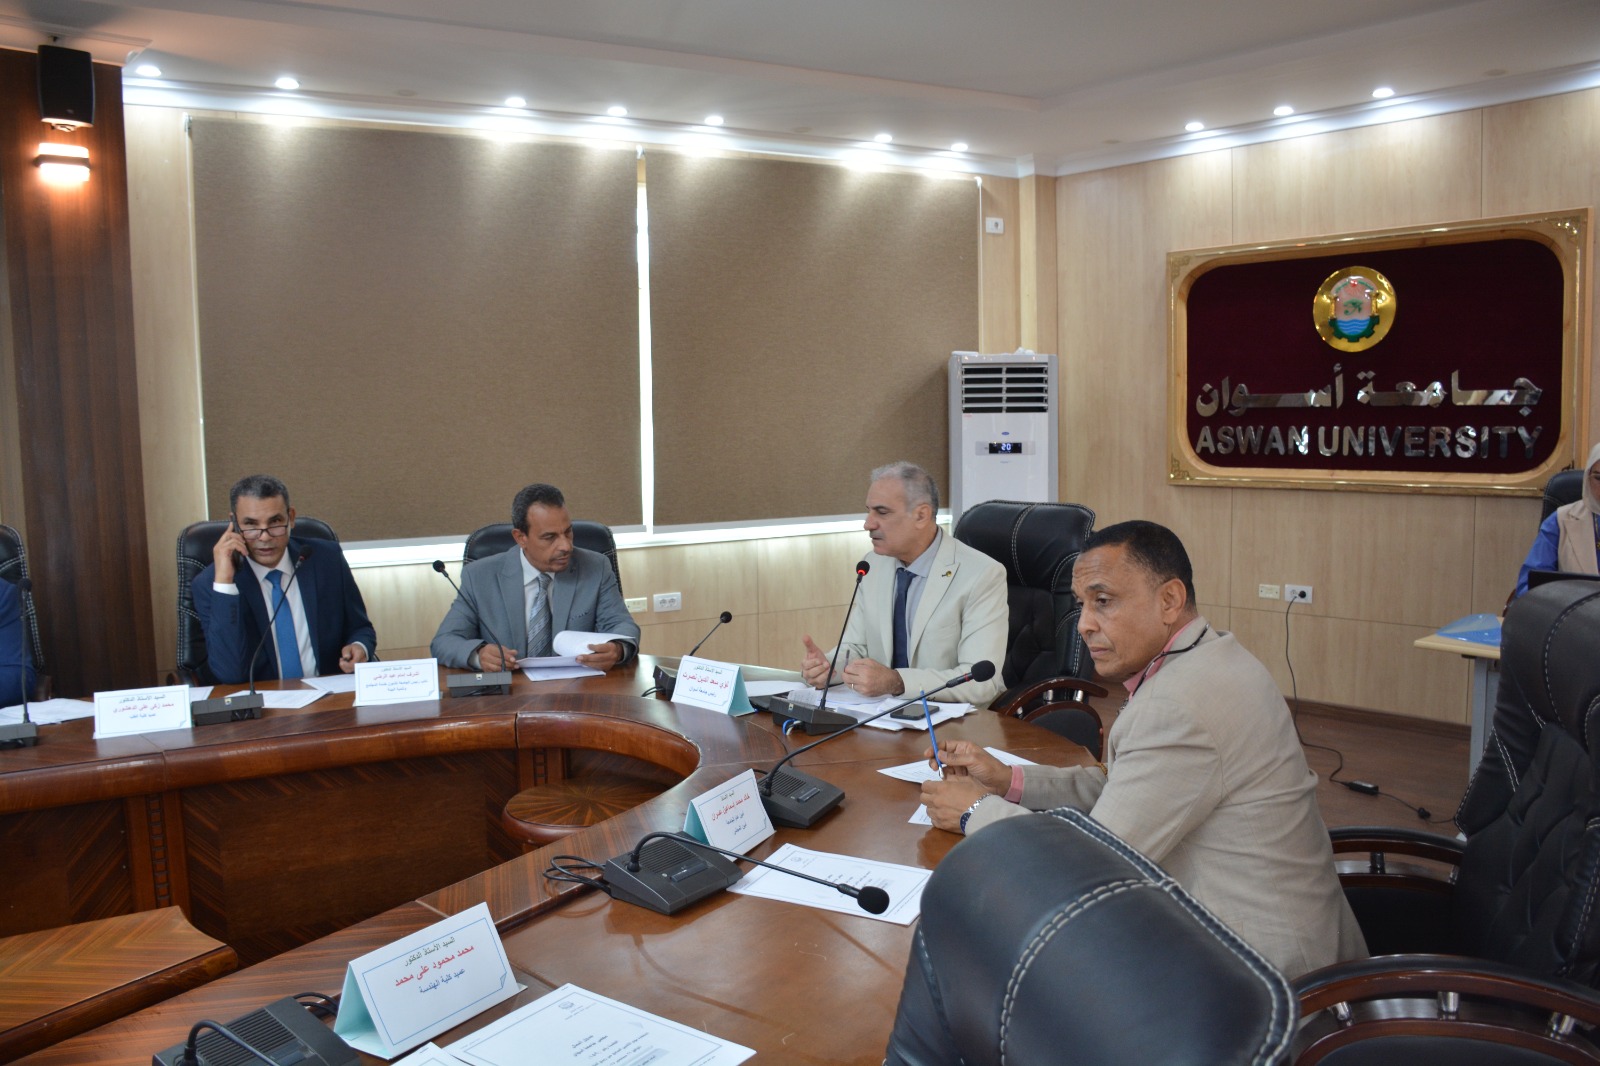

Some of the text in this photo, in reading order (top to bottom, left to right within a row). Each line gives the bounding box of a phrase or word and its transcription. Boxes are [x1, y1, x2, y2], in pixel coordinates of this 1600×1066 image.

[1196, 363, 1543, 417] جامعة أسوان
[1196, 425, 1542, 458] ASWAN UNIVERSITY
[442, 936, 455, 948] السيد
[457, 945, 474, 956] محمد
[405, 951, 422, 966] الدكتور
[433, 955, 455, 969] محمود
[396, 974, 414, 986] محمد
[419, 968, 465, 993] عميد كلية الهندسة
